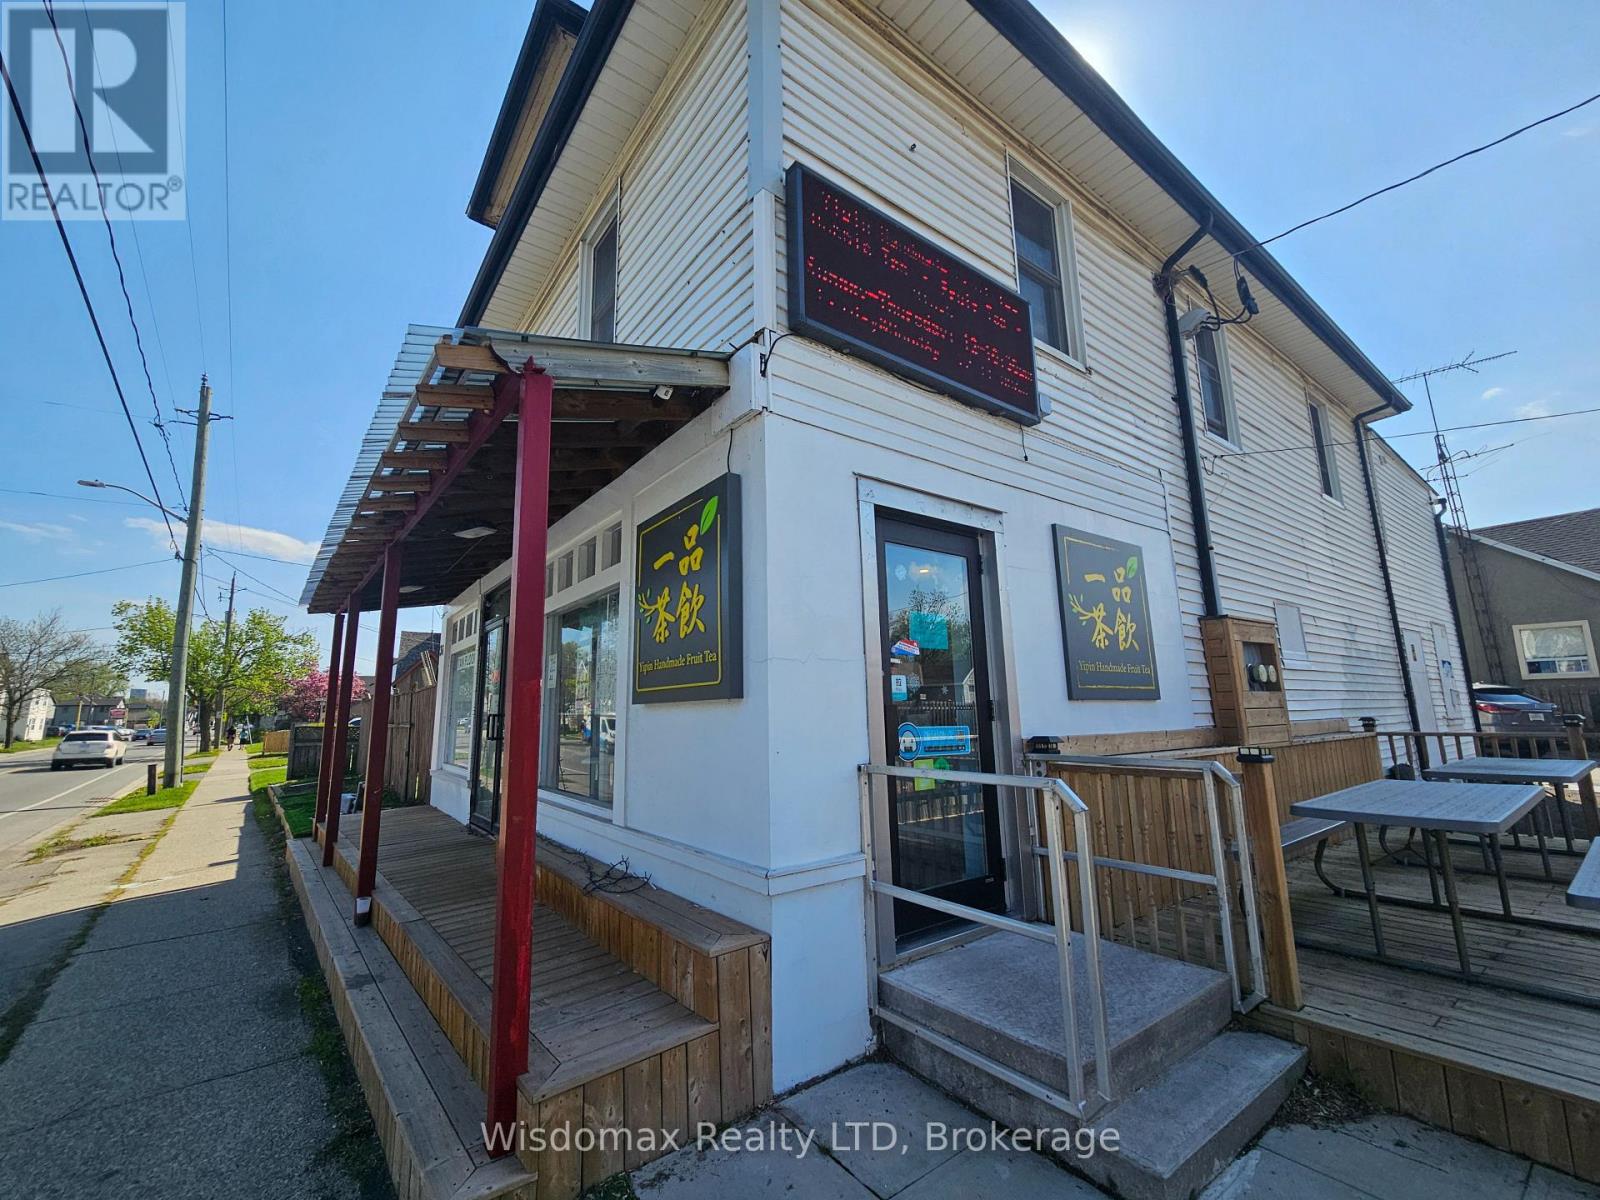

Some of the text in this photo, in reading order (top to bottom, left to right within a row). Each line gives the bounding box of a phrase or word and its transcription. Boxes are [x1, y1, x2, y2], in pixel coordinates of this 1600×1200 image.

[653, 523, 704, 576] 一品
[1084, 566, 1132, 604] 一品
[654, 654, 686, 670] Handmade
[686, 651, 703, 665] Fruit
[704, 650, 718, 663] Tea
[1141, 664, 1152, 674] Tea
